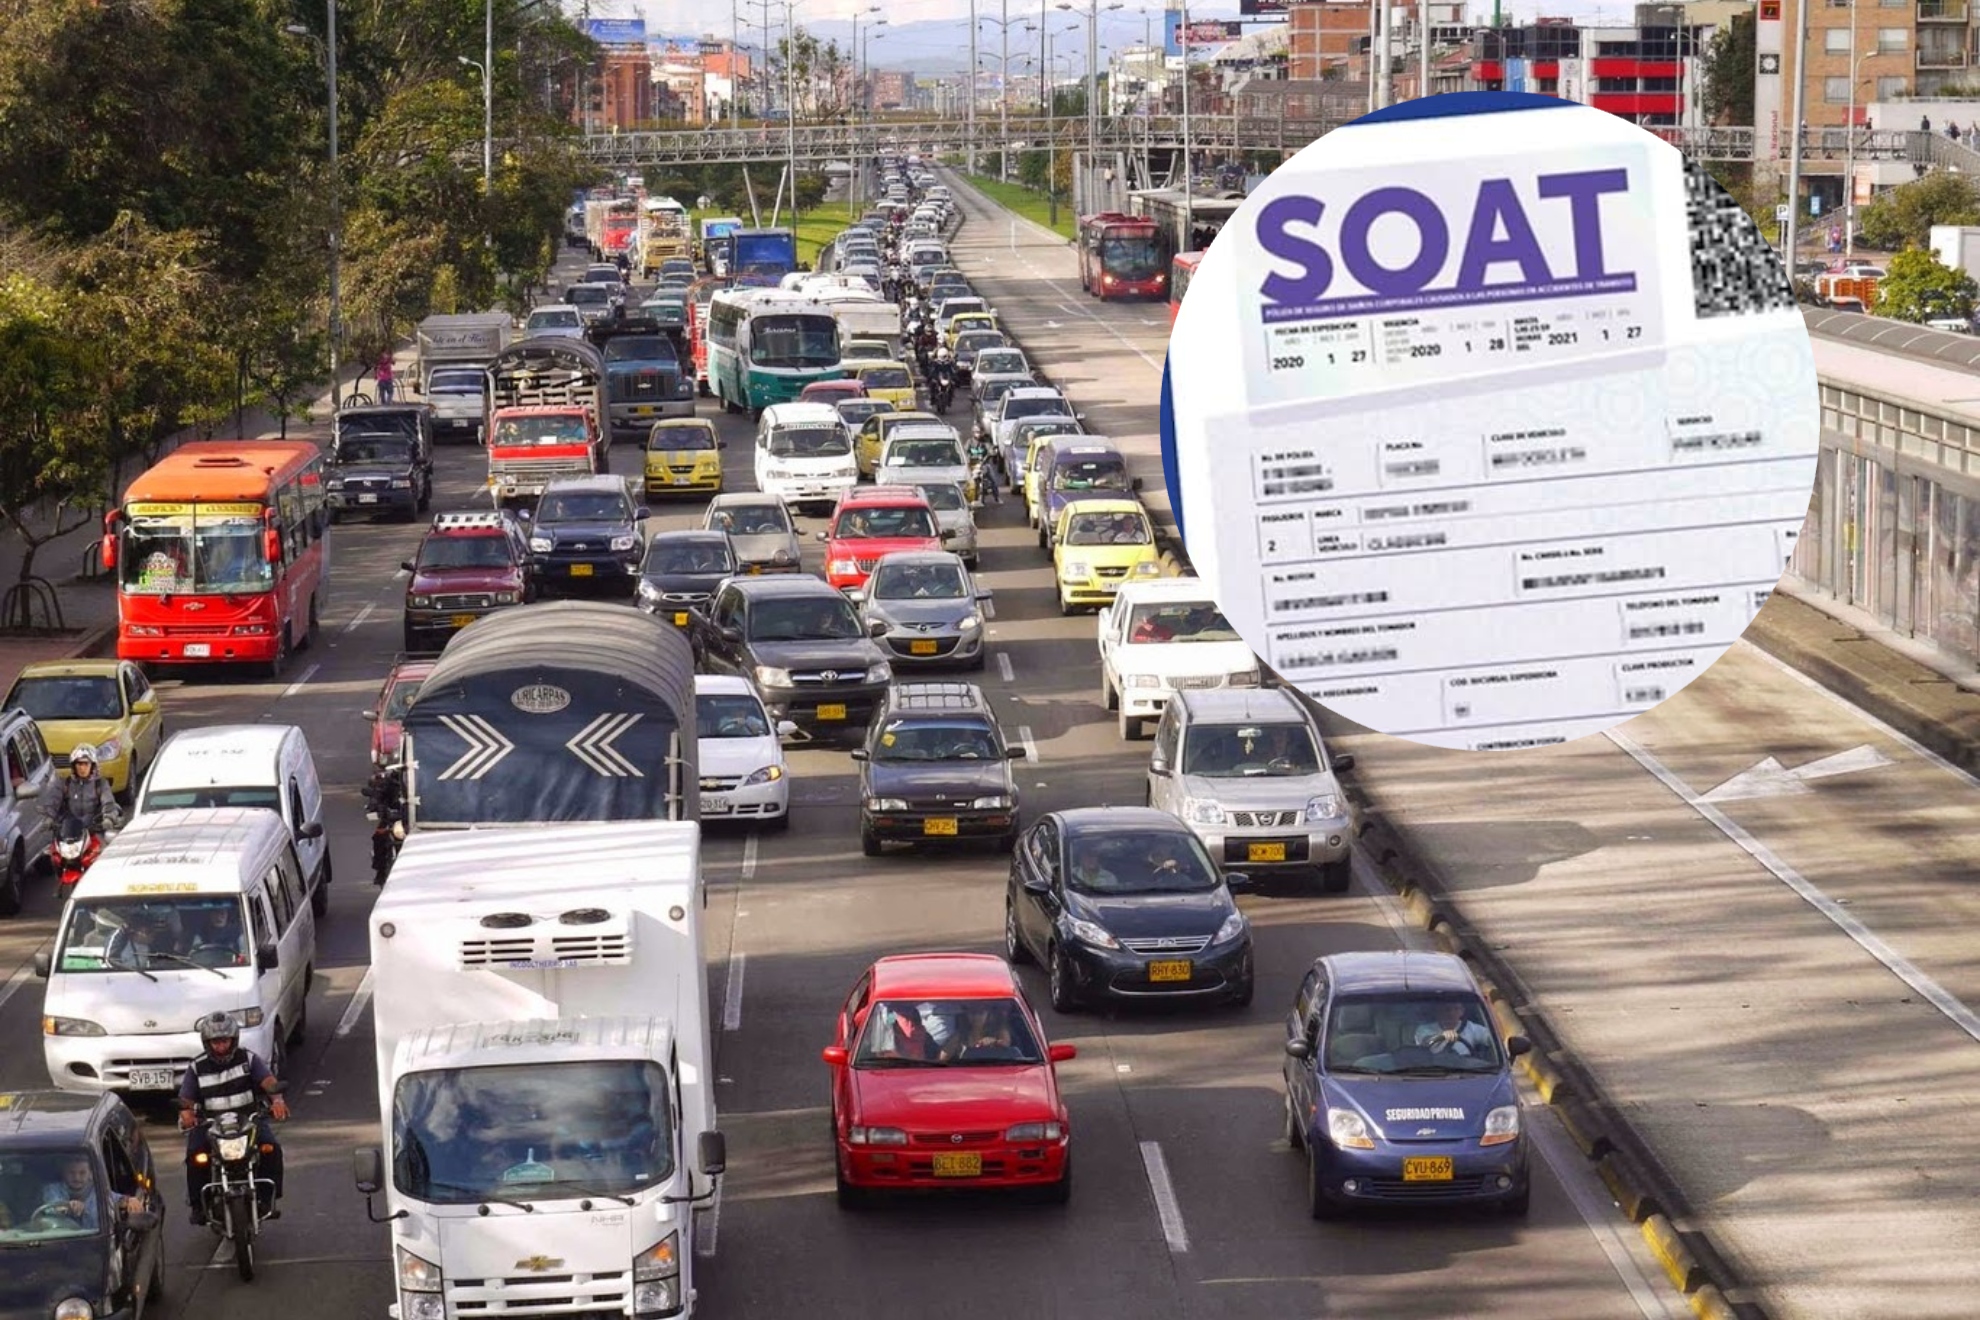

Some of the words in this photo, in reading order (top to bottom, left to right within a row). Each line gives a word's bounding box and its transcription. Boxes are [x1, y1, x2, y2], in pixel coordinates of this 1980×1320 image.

[1256, 168, 1628, 302] SOAT
[1294, 307, 1304, 316] DE
[1336, 303, 1346, 312] DE
[1274, 327, 1299, 336] FECHA
[1548, 332, 1578, 346] 2021
[1602, 329, 1609, 341] 1
[1627, 326, 1642, 339] 27
[1411, 344, 1442, 358] 2020
[1465, 342, 1471, 353] 1
[1489, 339, 1504, 351] 28
[1273, 356, 1304, 369] 2020
[1328, 353, 1335, 365] 1
[1352, 351, 1366, 363] 27
[1315, 509, 1342, 518] MARCA
[1268, 540, 1276, 552] 2
[1385, 1108, 1430, 1121] SEGURIDAD
[1430, 1107, 1465, 1120] PRIVADA
